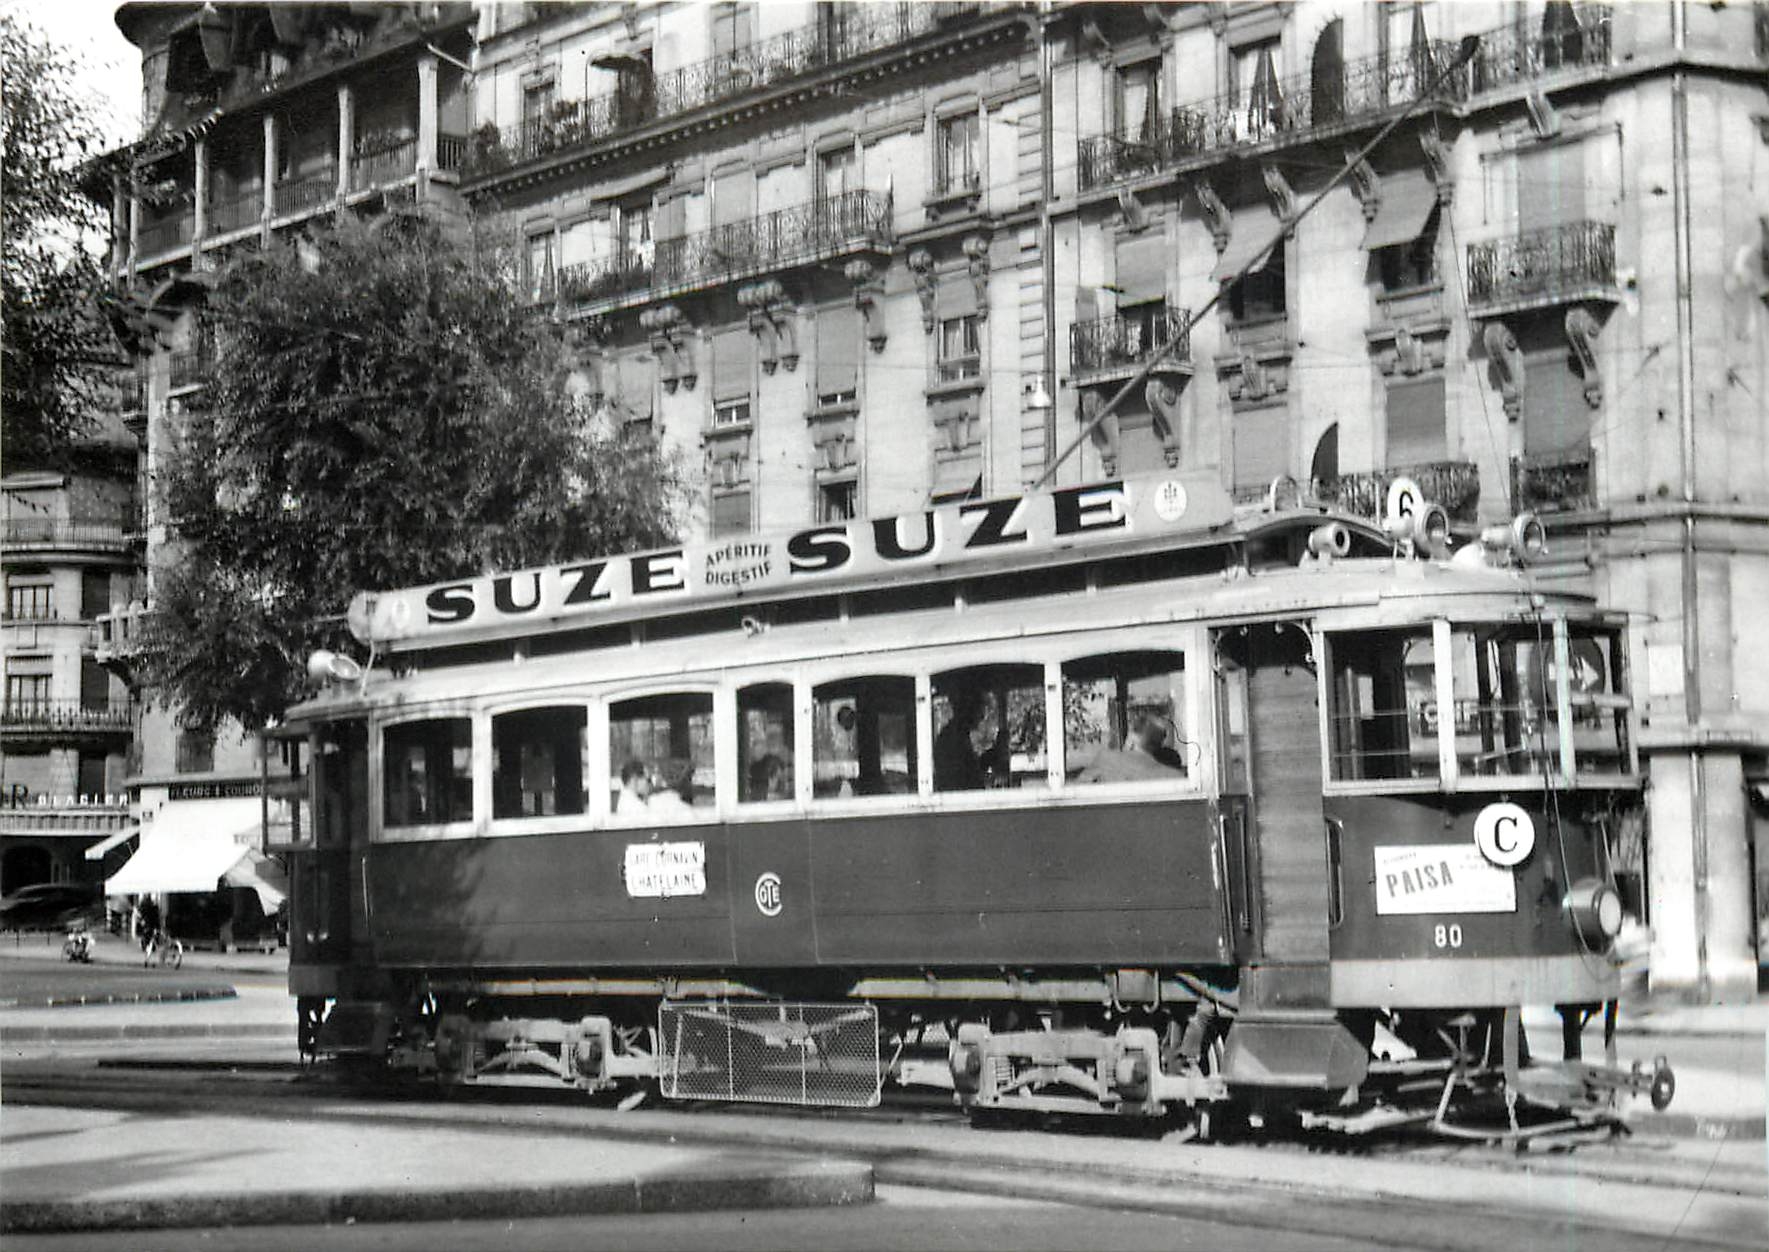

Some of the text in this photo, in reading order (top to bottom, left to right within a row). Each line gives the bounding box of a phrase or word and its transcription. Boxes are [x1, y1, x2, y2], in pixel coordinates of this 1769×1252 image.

[787, 481, 1126, 575] SUZE
[426, 550, 685, 624] SUZE
[705, 561, 770, 585] DIGESTIF
[1494, 816, 1518, 852] C
[1386, 860, 1454, 898] PAISA
[1435, 923, 1463, 948] 80
